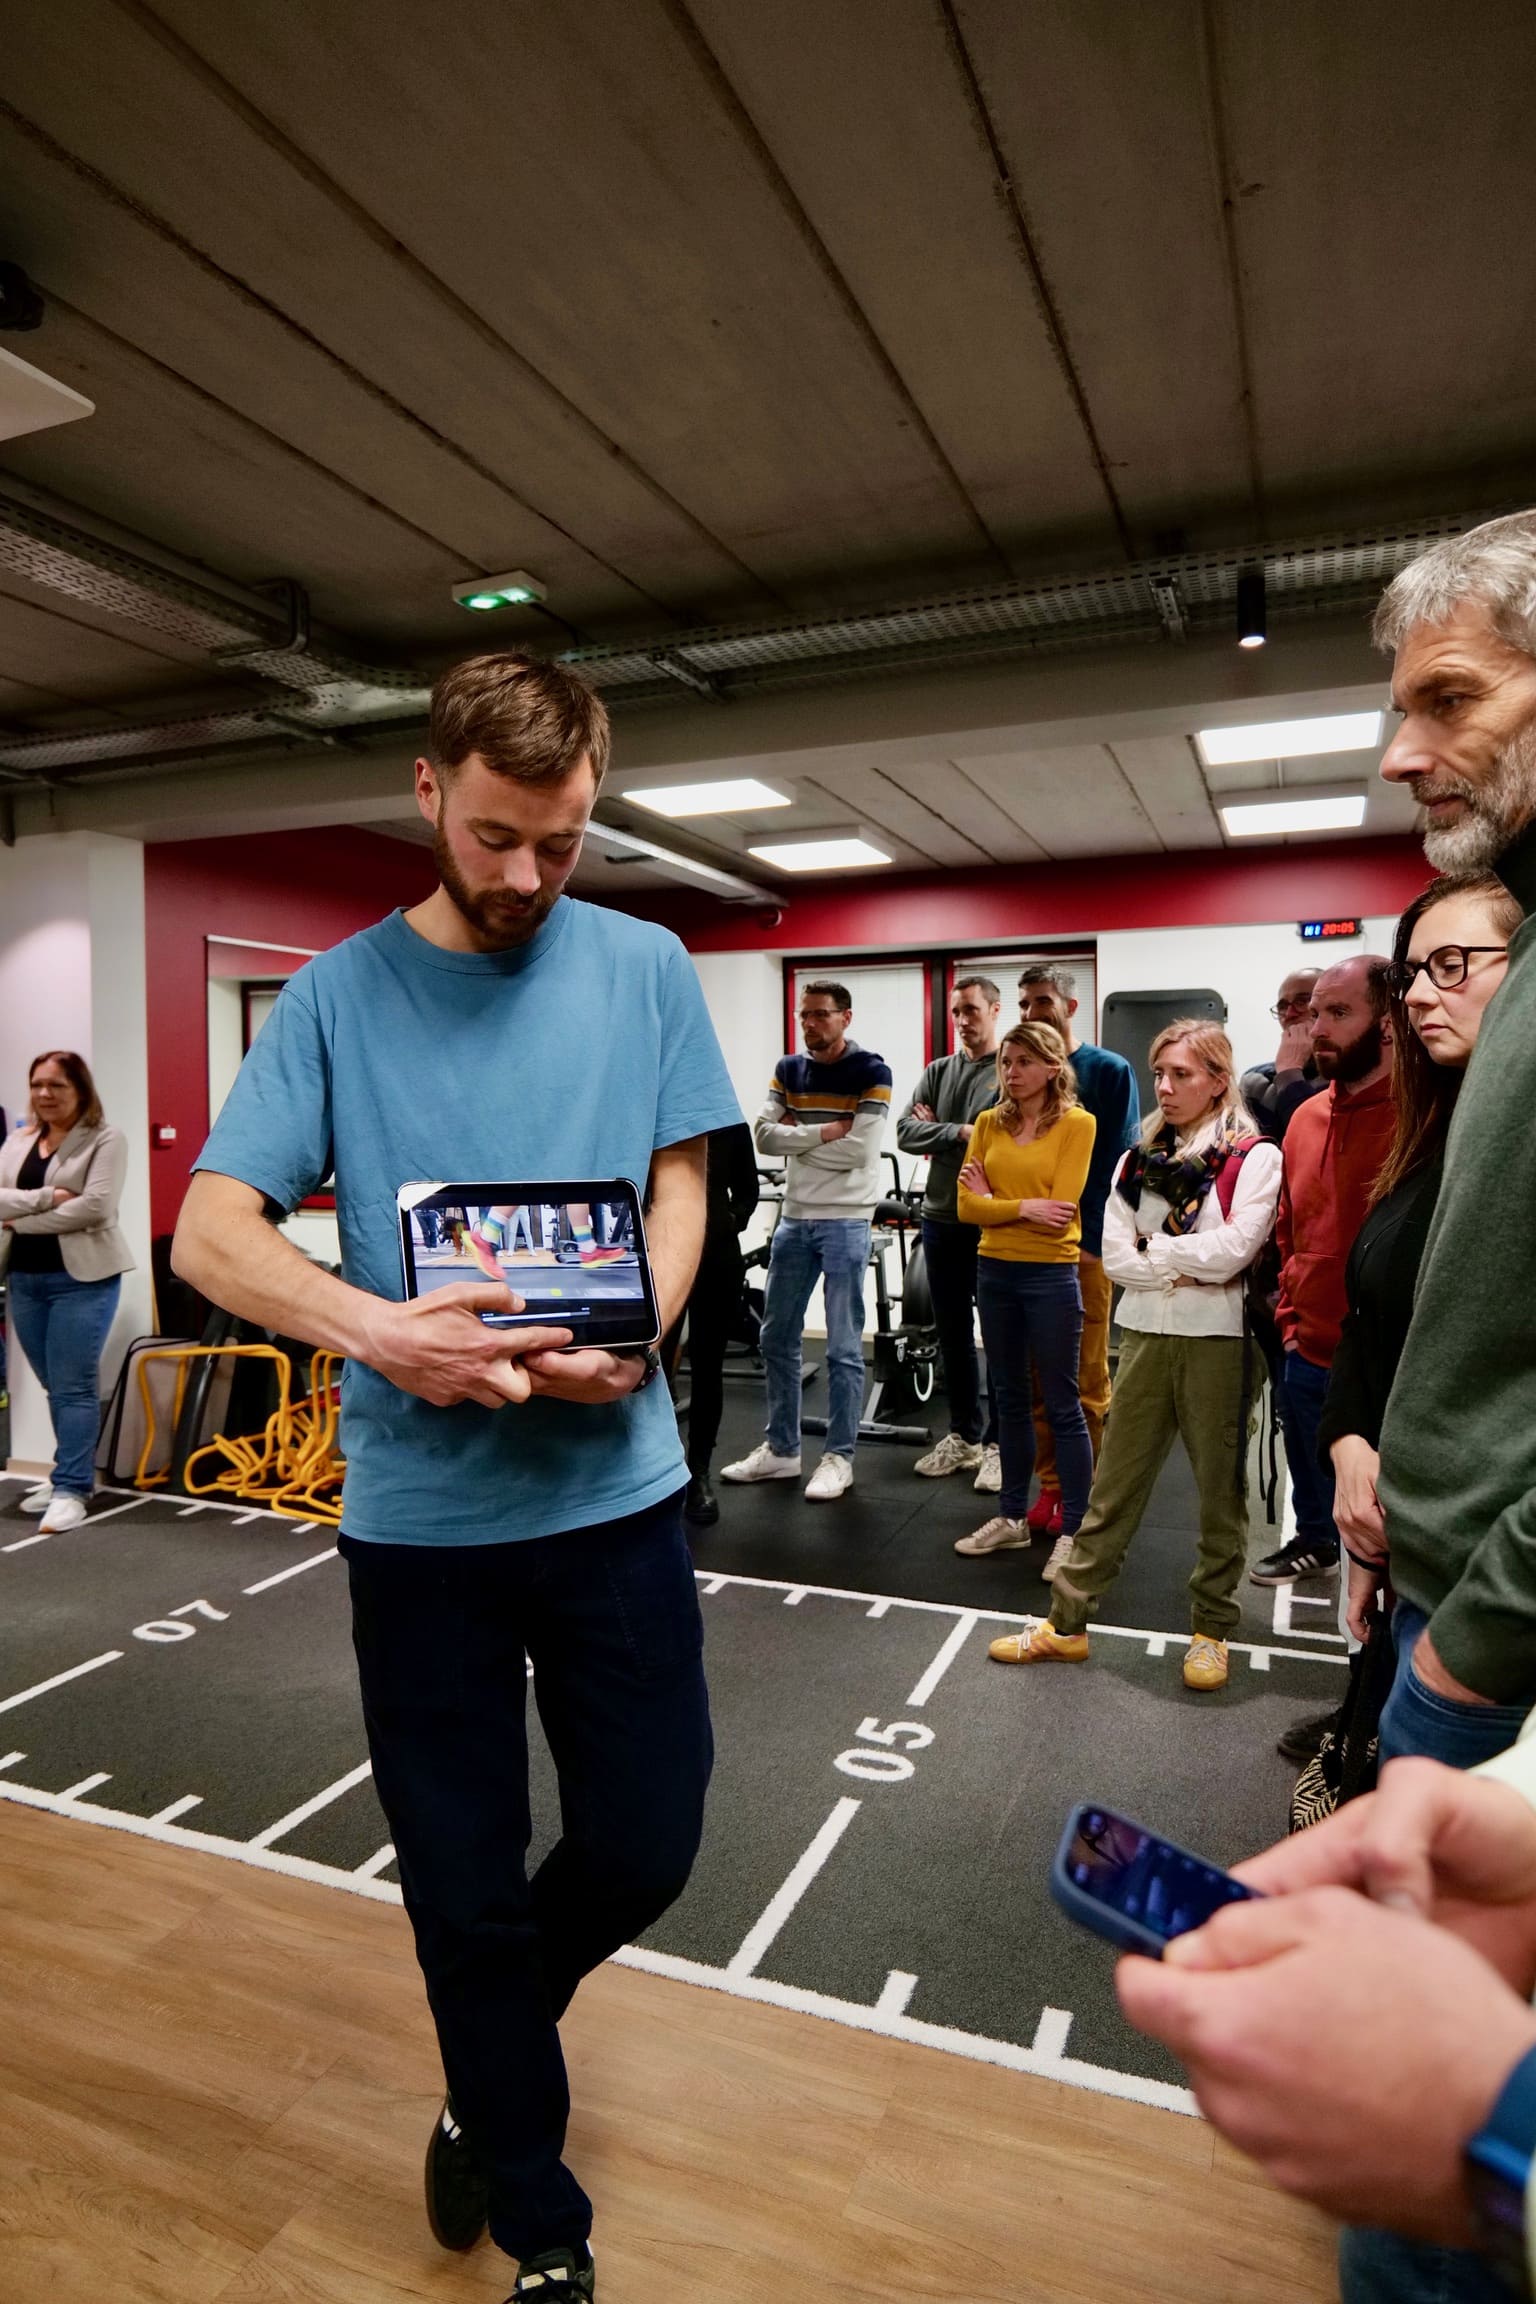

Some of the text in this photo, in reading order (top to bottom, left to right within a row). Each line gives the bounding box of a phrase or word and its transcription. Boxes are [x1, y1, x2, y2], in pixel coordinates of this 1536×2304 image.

[1322, 921, 1355, 935] 20:05
[132, 1599, 232, 1642] 07
[832, 1716, 936, 1782] 05
